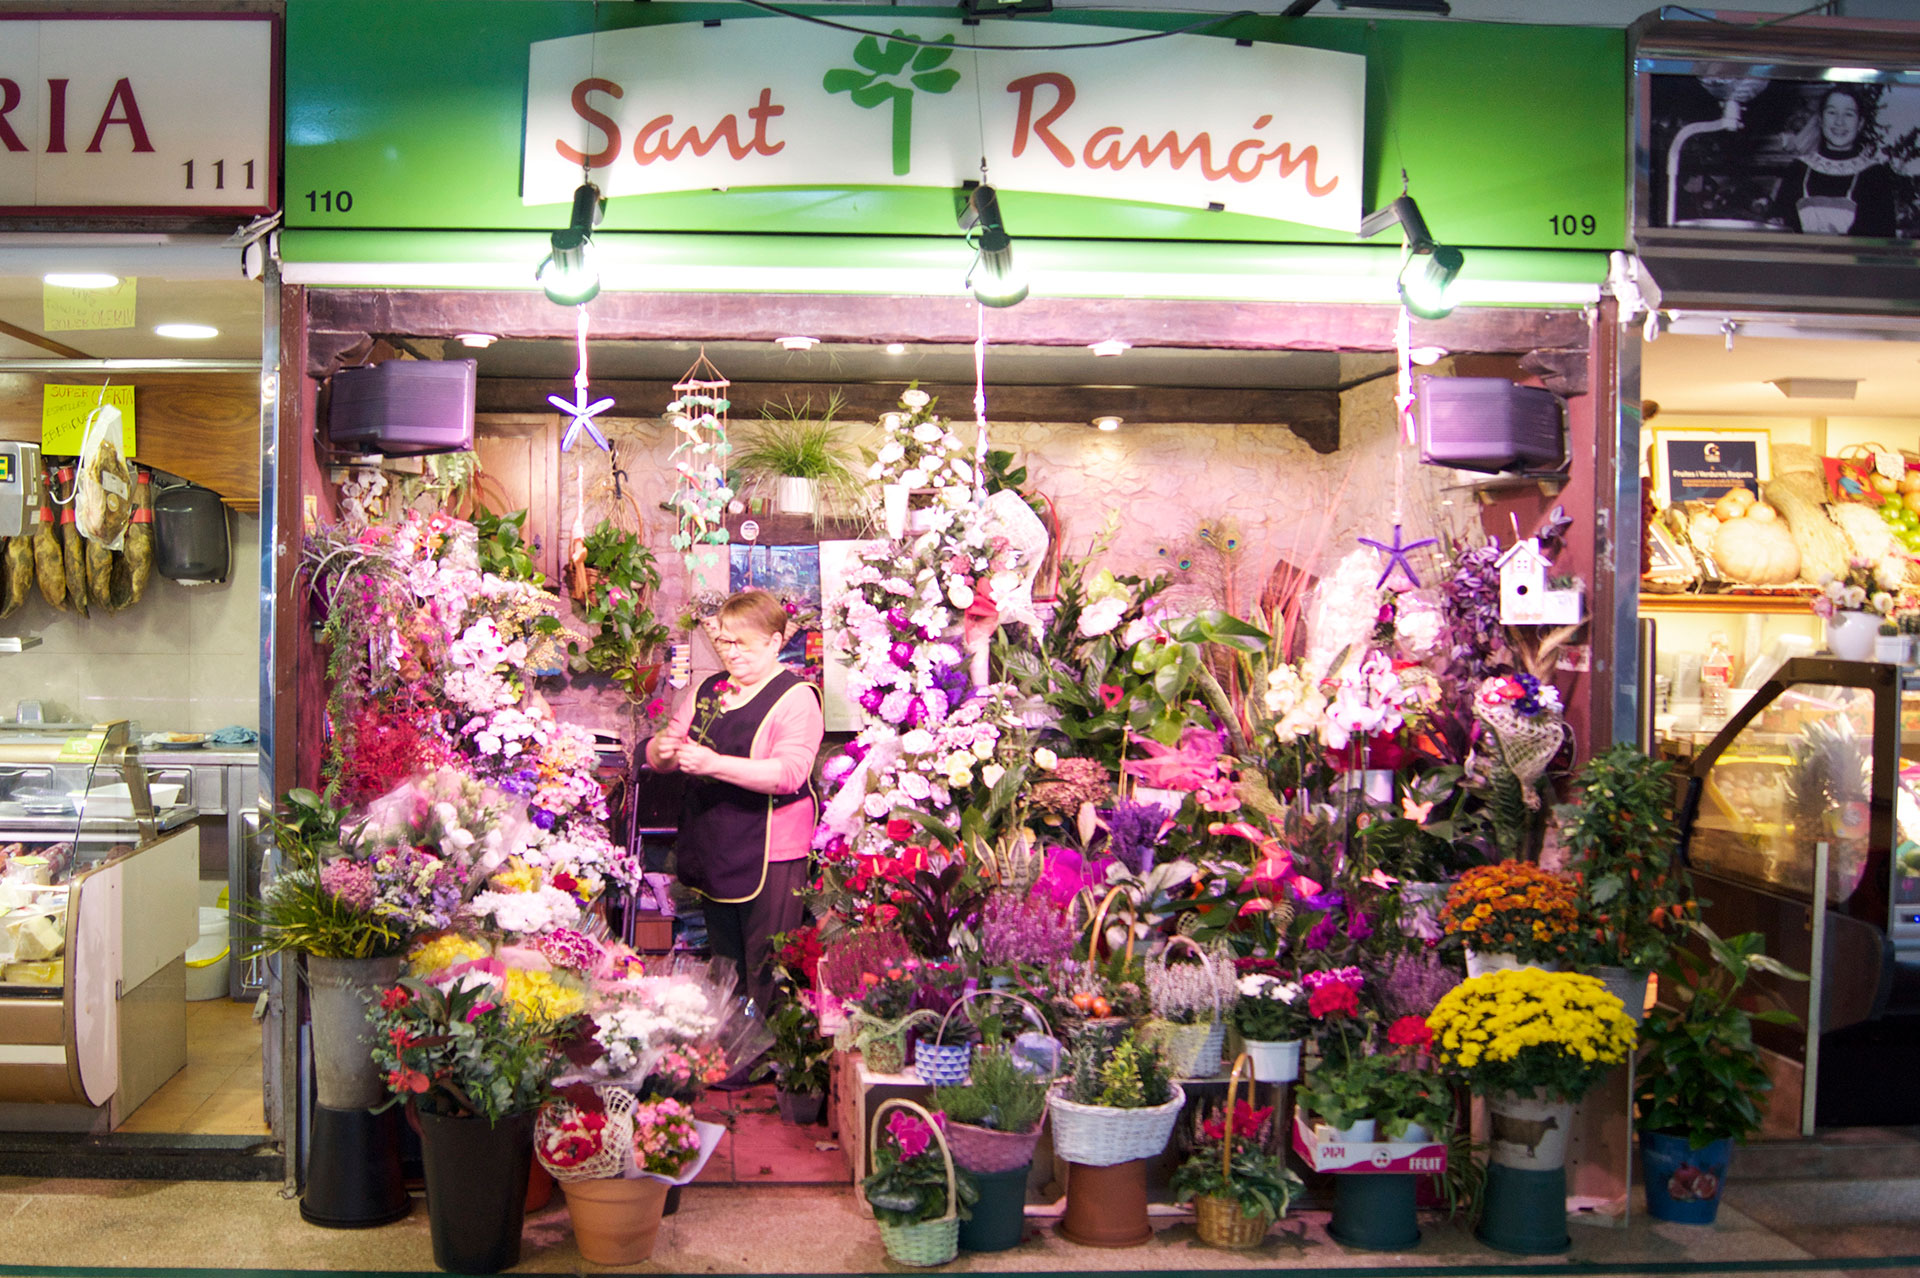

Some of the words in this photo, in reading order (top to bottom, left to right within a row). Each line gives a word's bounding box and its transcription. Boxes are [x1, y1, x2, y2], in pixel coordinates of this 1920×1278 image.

[0, 77, 156, 153] RIA
[555, 77, 786, 169] Sant
[1006, 72, 1340, 198] Ramón
[181, 158, 255, 190] 111
[305, 190, 353, 212] 110
[1549, 214, 1596, 236] 109
[50, 386, 89, 398] SUPER
